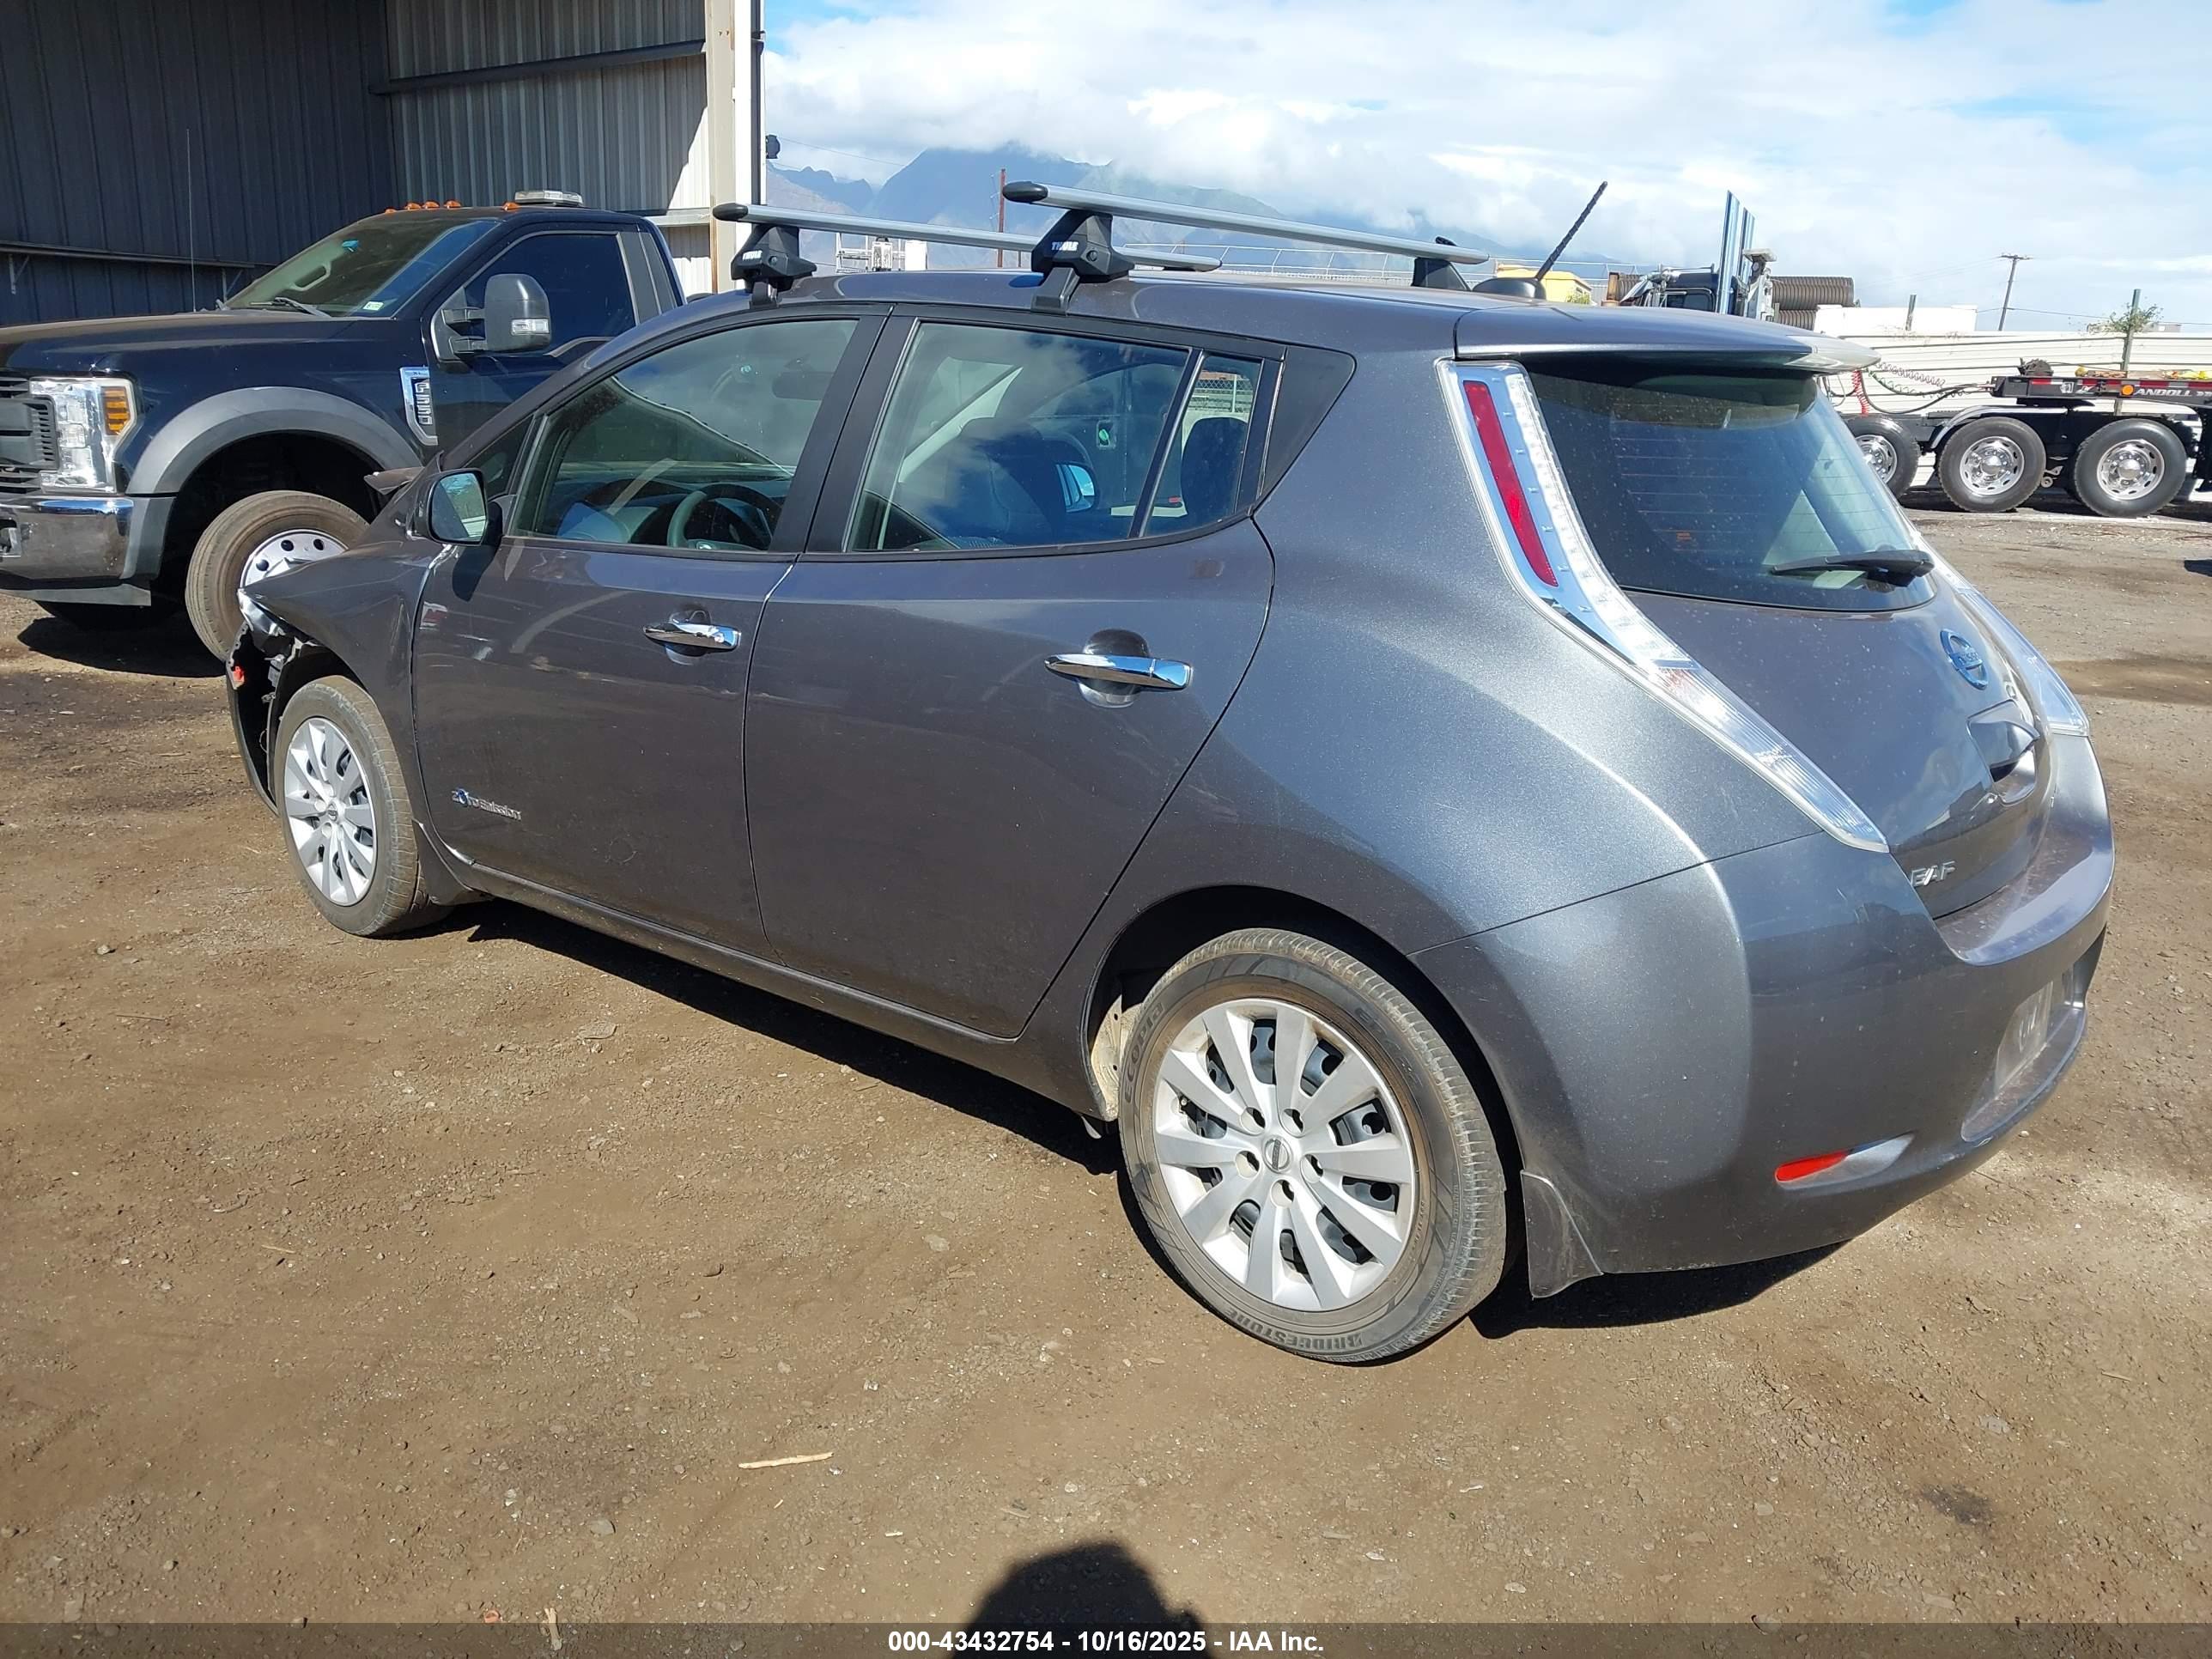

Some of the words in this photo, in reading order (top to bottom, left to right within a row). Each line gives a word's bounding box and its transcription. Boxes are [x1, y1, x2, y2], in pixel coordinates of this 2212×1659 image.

[1051, 241, 1079, 252] THULE
[2134, 387, 2192, 397] ANDOLL
[1911, 860, 1955, 886] EAF
[1224, 1306, 1364, 1350] BRIDGESTONE
